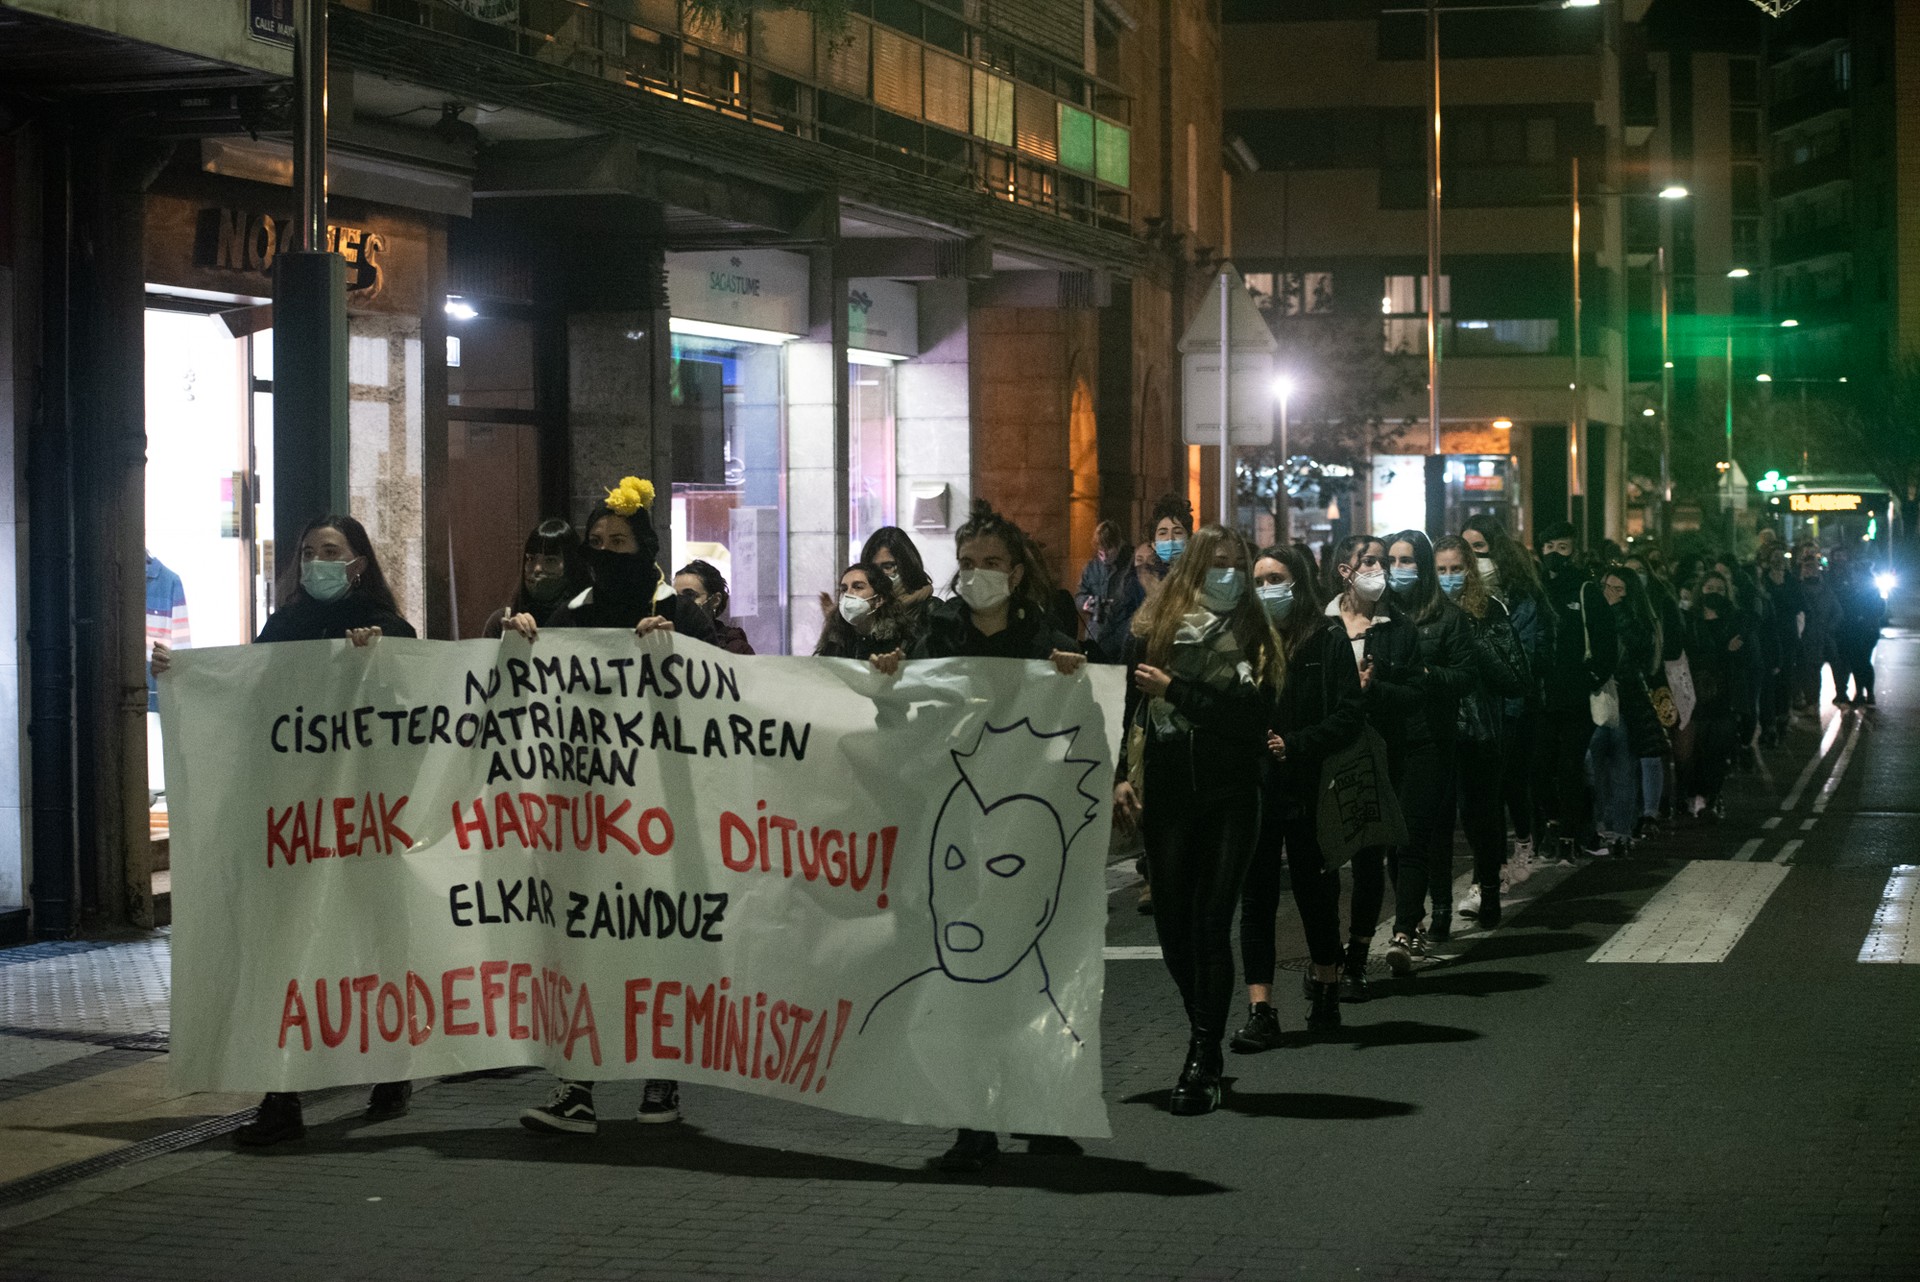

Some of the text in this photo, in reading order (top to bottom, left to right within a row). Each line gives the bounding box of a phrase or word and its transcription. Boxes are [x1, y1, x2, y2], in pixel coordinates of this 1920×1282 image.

[255, 16, 275, 32] CALLE
[709, 271, 760, 297] SAGASTUME
[271, 696, 811, 761] CISHETEROATRIARKALAREN
[487, 742, 639, 787] AURREAN
[266, 791, 415, 869] KALEAK
[451, 791, 674, 856] HARTUKO
[449, 876, 556, 927] ELKAR
[277, 959, 602, 1067] AUTODEFENTSA
